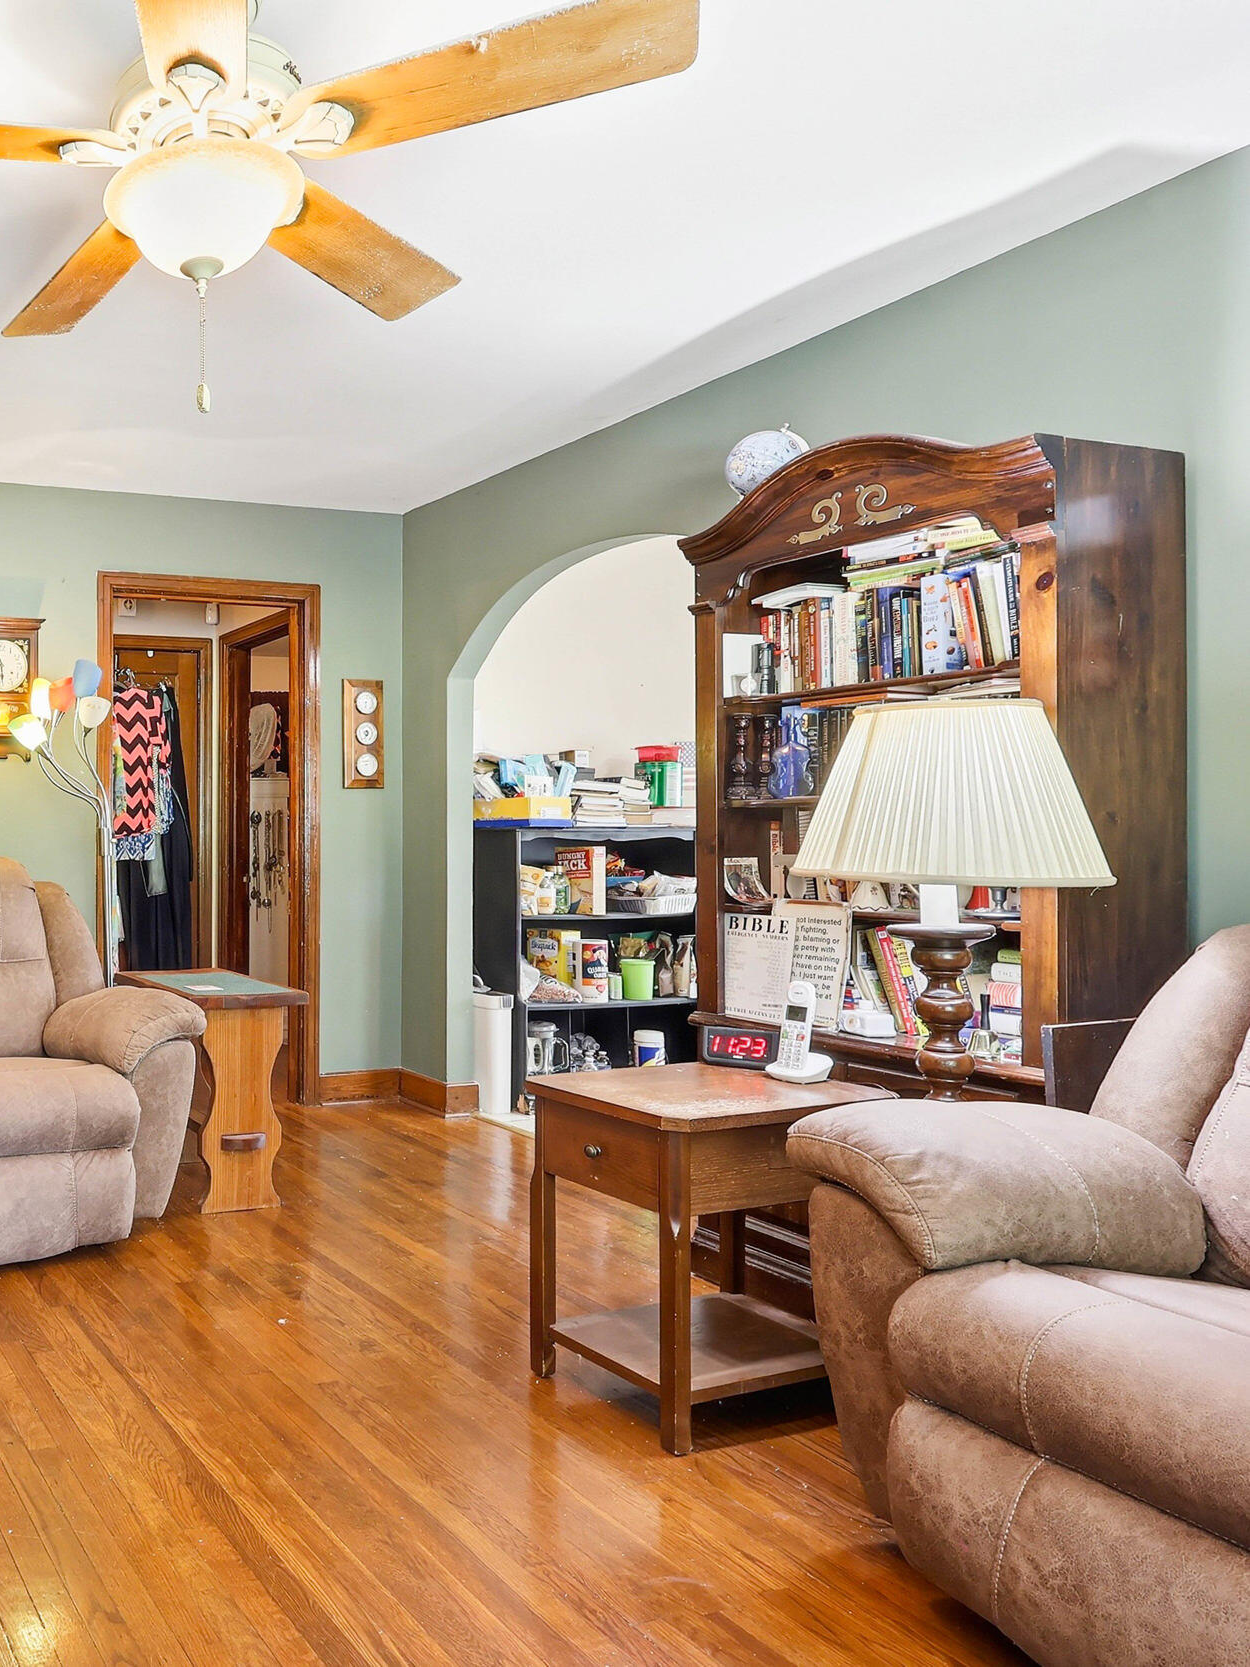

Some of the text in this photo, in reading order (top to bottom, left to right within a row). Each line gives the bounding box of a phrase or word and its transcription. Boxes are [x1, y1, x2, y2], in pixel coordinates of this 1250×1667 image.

[729, 916, 789, 934] BIBLE
[808, 917, 842, 926] interested
[805, 954, 840, 965] remaining
[713, 1036, 766, 1058] 11:23
